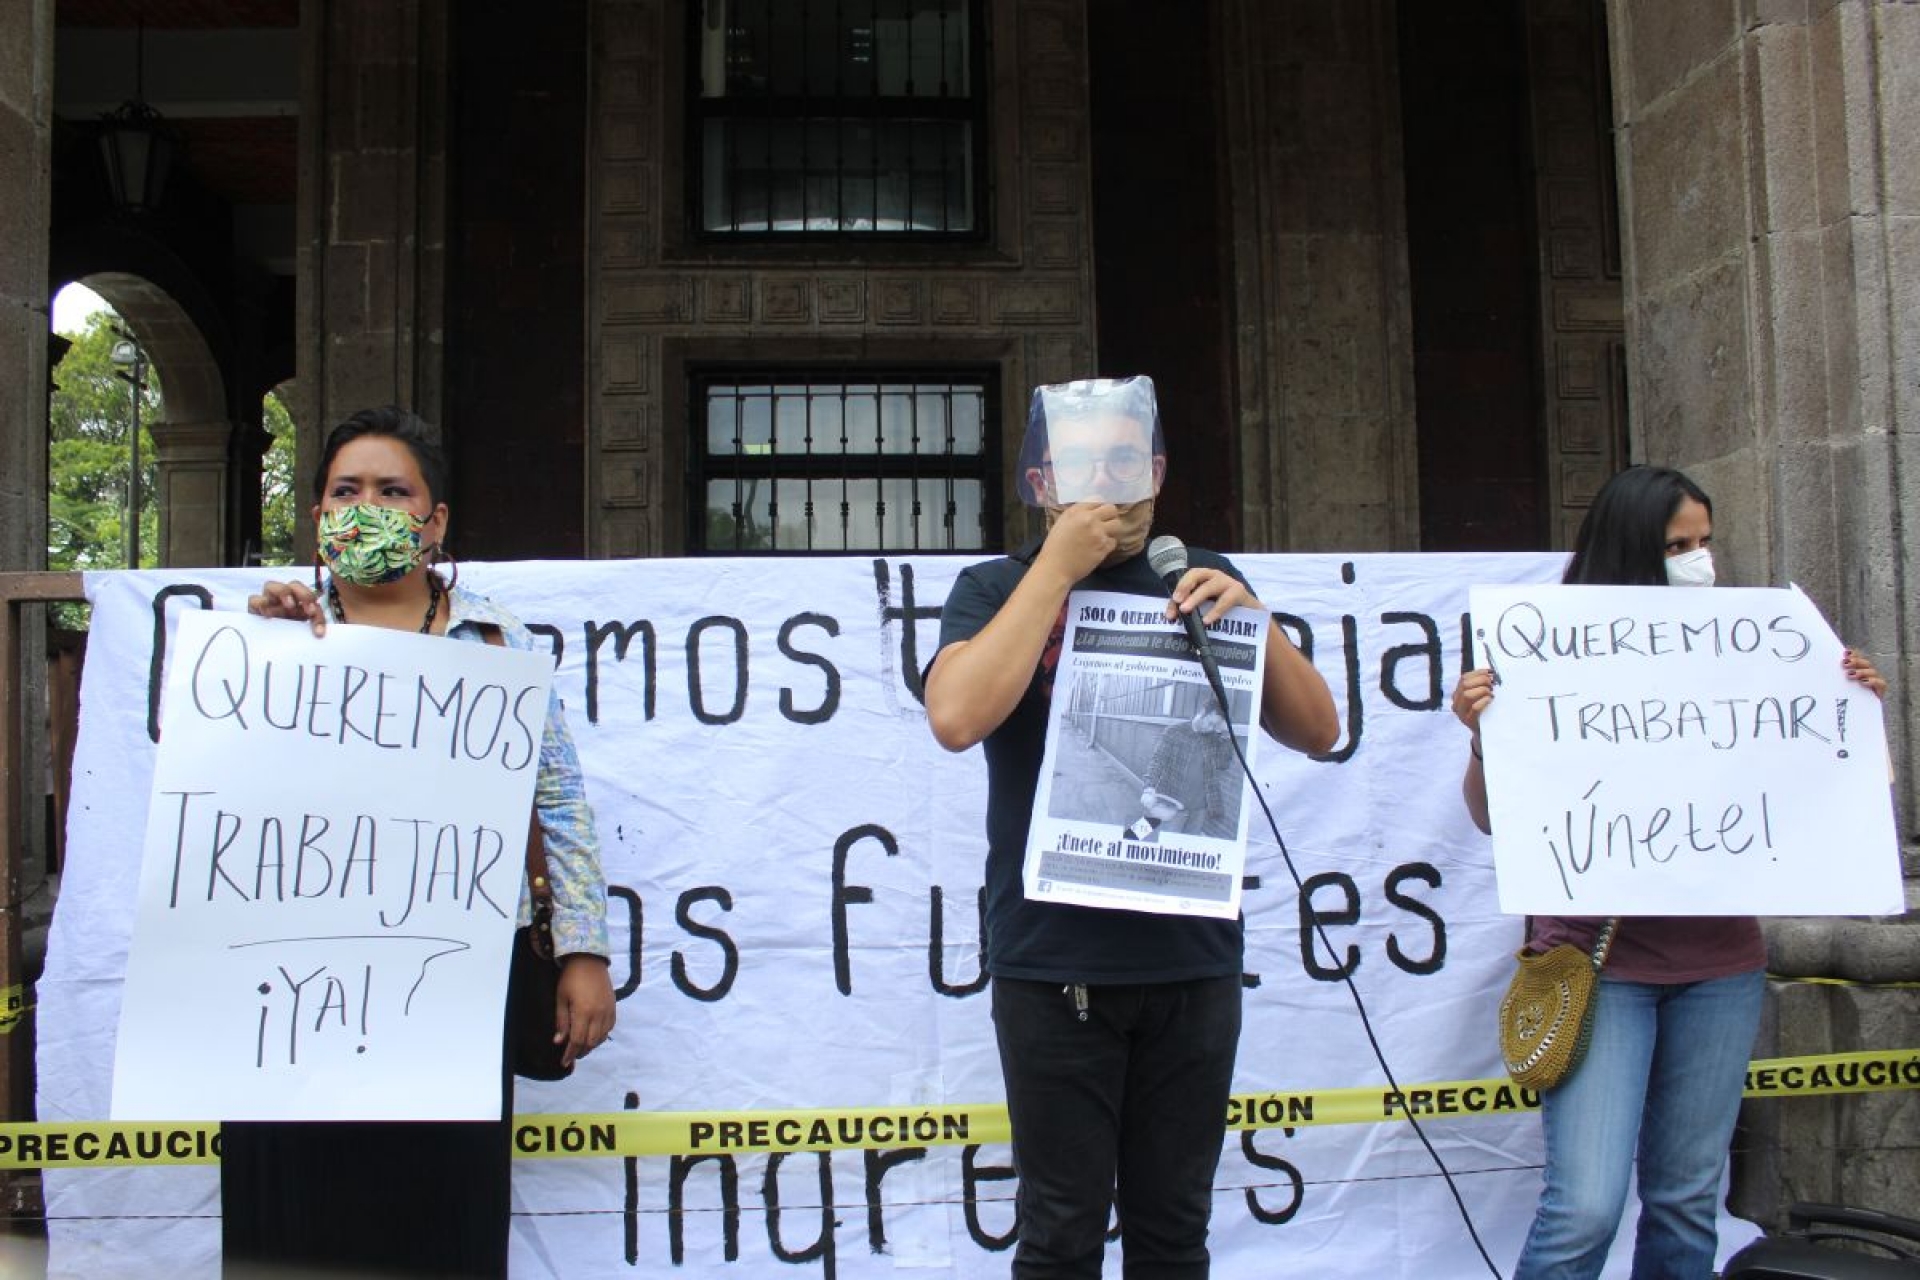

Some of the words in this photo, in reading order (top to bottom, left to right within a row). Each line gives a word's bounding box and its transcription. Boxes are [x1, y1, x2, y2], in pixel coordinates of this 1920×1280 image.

[1079, 606, 1116, 623] ¡SOLO
[1121, 610, 1184, 626] QUEREM
[1206, 617, 1258, 638] BAJAR!
[192, 625, 539, 771] QUEREMOS
[1527, 692, 1850, 759] TRABAJAR!
[161, 790, 510, 927] TRABAJAR
[1106, 840, 1122, 858] al
[1126, 844, 1221, 870] movimiento!
[1543, 780, 1778, 900] ¡Únete!
[256, 964, 371, 1068] ¡YA!
[0, 1131, 221, 1162] RECAUCI
[690, 1111, 970, 1149] PRECAUCIÓN
[1384, 1085, 1541, 1115] PRECAU
[1745, 1056, 1920, 1090] ECAUCIÓ
